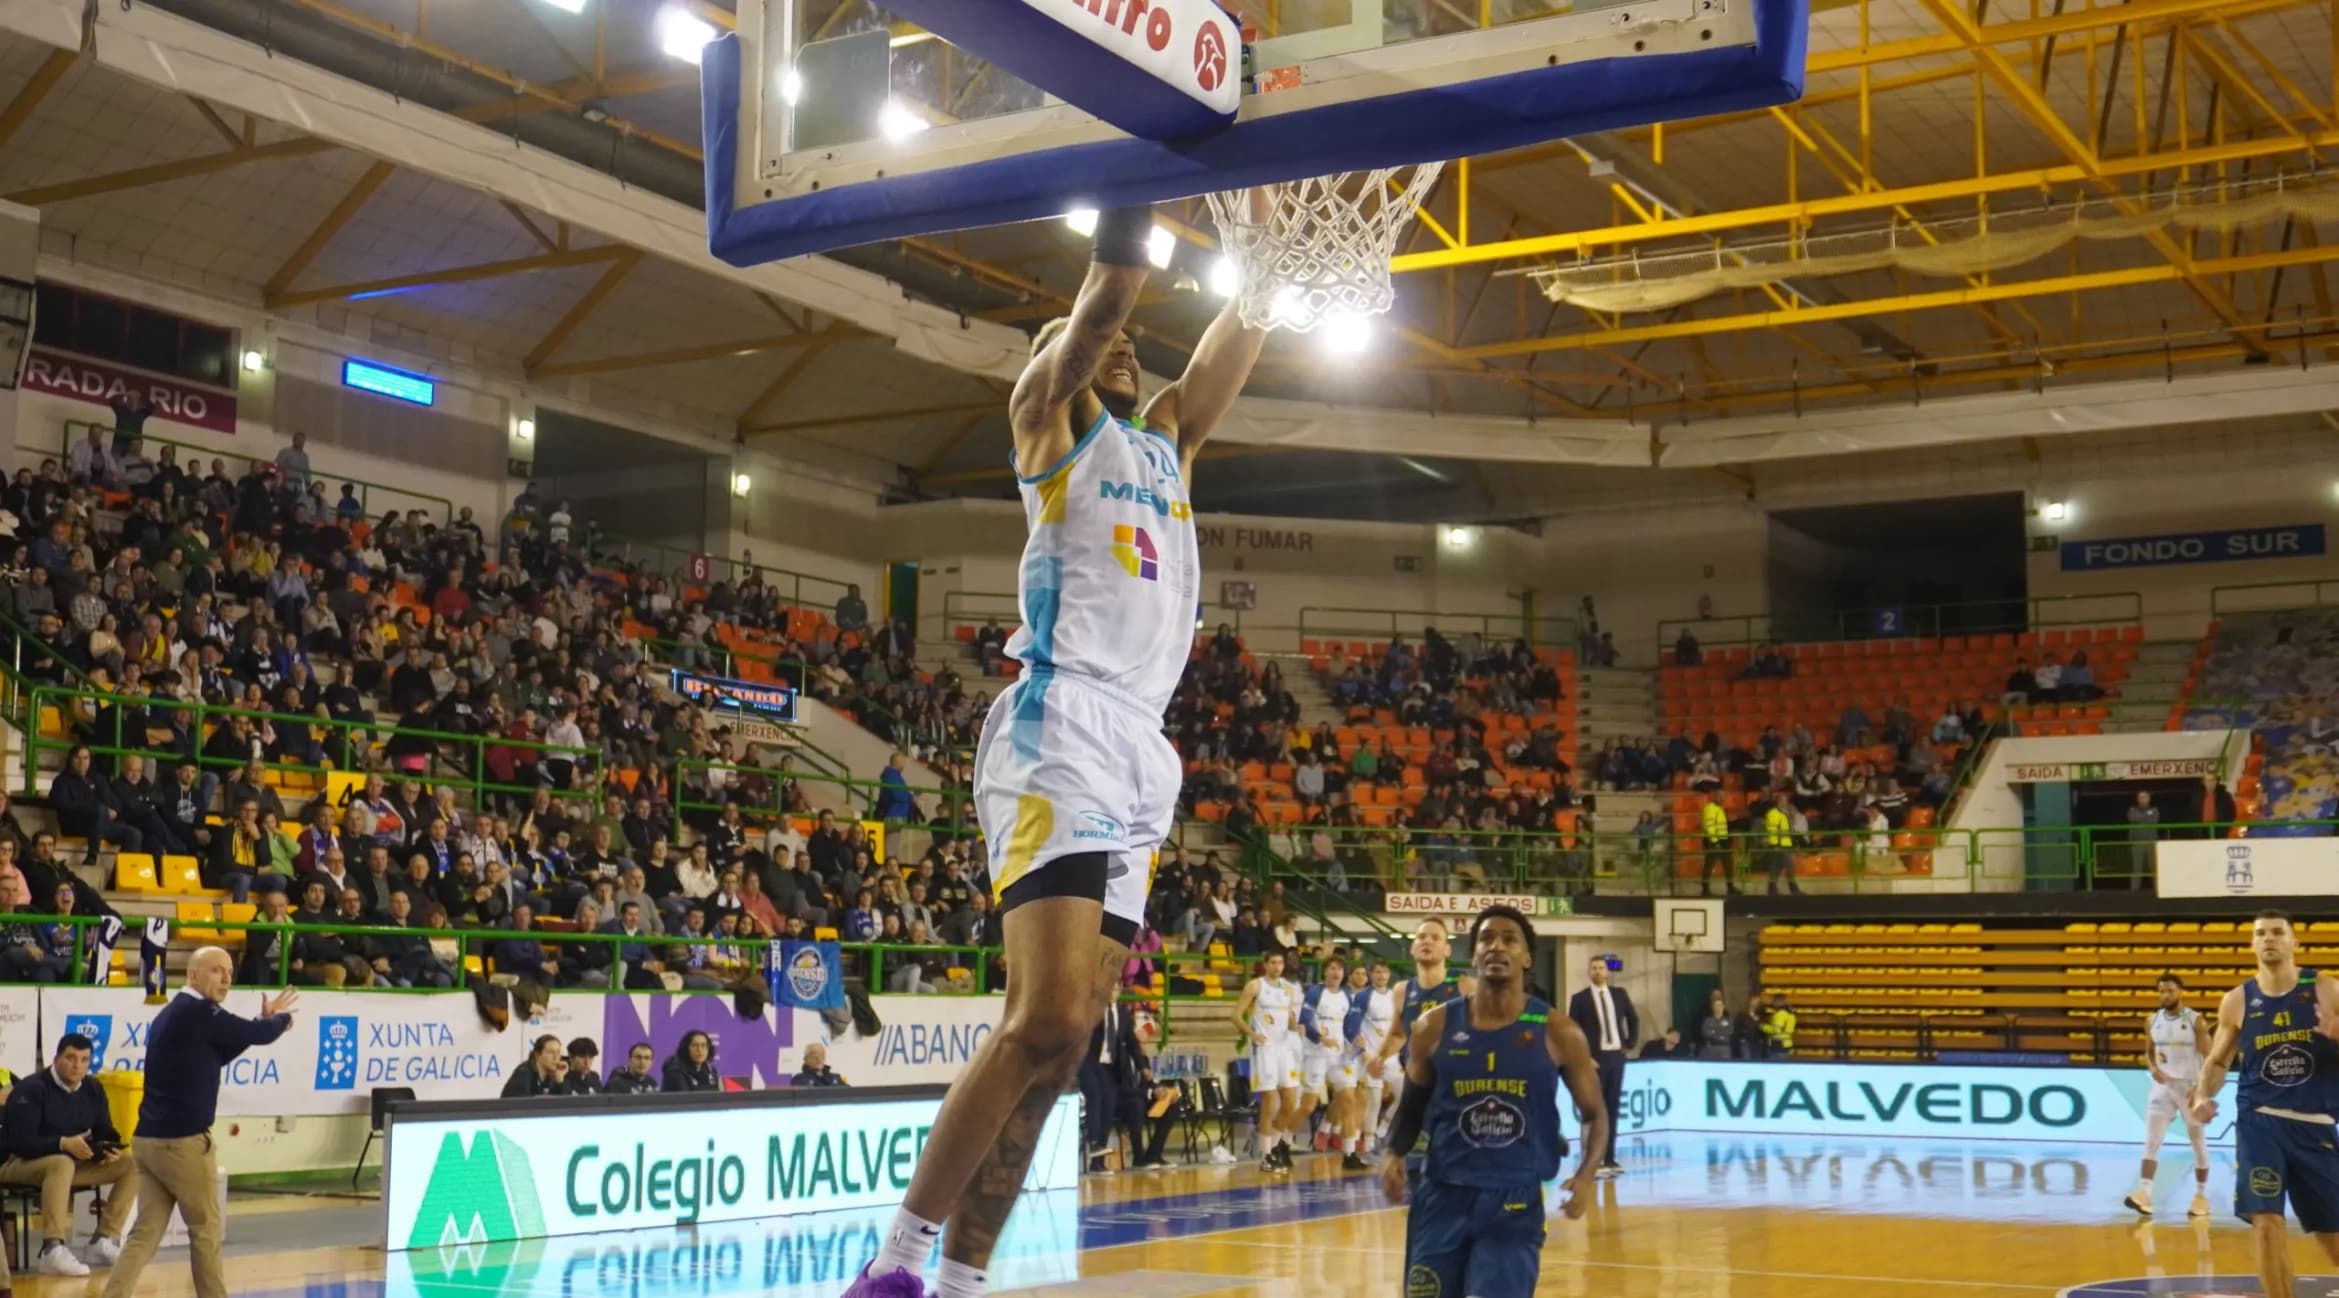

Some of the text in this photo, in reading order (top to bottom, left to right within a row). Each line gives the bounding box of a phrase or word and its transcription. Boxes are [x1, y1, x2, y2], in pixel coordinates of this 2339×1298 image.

[150, 385, 208, 419] RIO
[1235, 528, 1313, 551] FUMAR
[2084, 532, 2300, 565] FONDO SUR
[694, 558, 705, 578] 6
[1882, 612, 1896, 631] 2
[2017, 762, 2217, 780] SAIDA EMERXENC
[338, 782, 353, 807] 4
[1390, 896, 1443, 910] SAIDA
[1449, 897, 1457, 910] E
[2273, 1011, 2291, 1027] 41
[369, 1023, 454, 1048] XUNTA
[2255, 1029, 2314, 1050] OURENSE
[366, 1054, 500, 1083] DE GALICIA
[1487, 1052, 1495, 1072] 1
[1454, 1079, 1527, 1098] OURENSE
[1618, 1079, 2087, 1129] egio MALVEDO
[566, 1138, 745, 1225] Colegio
